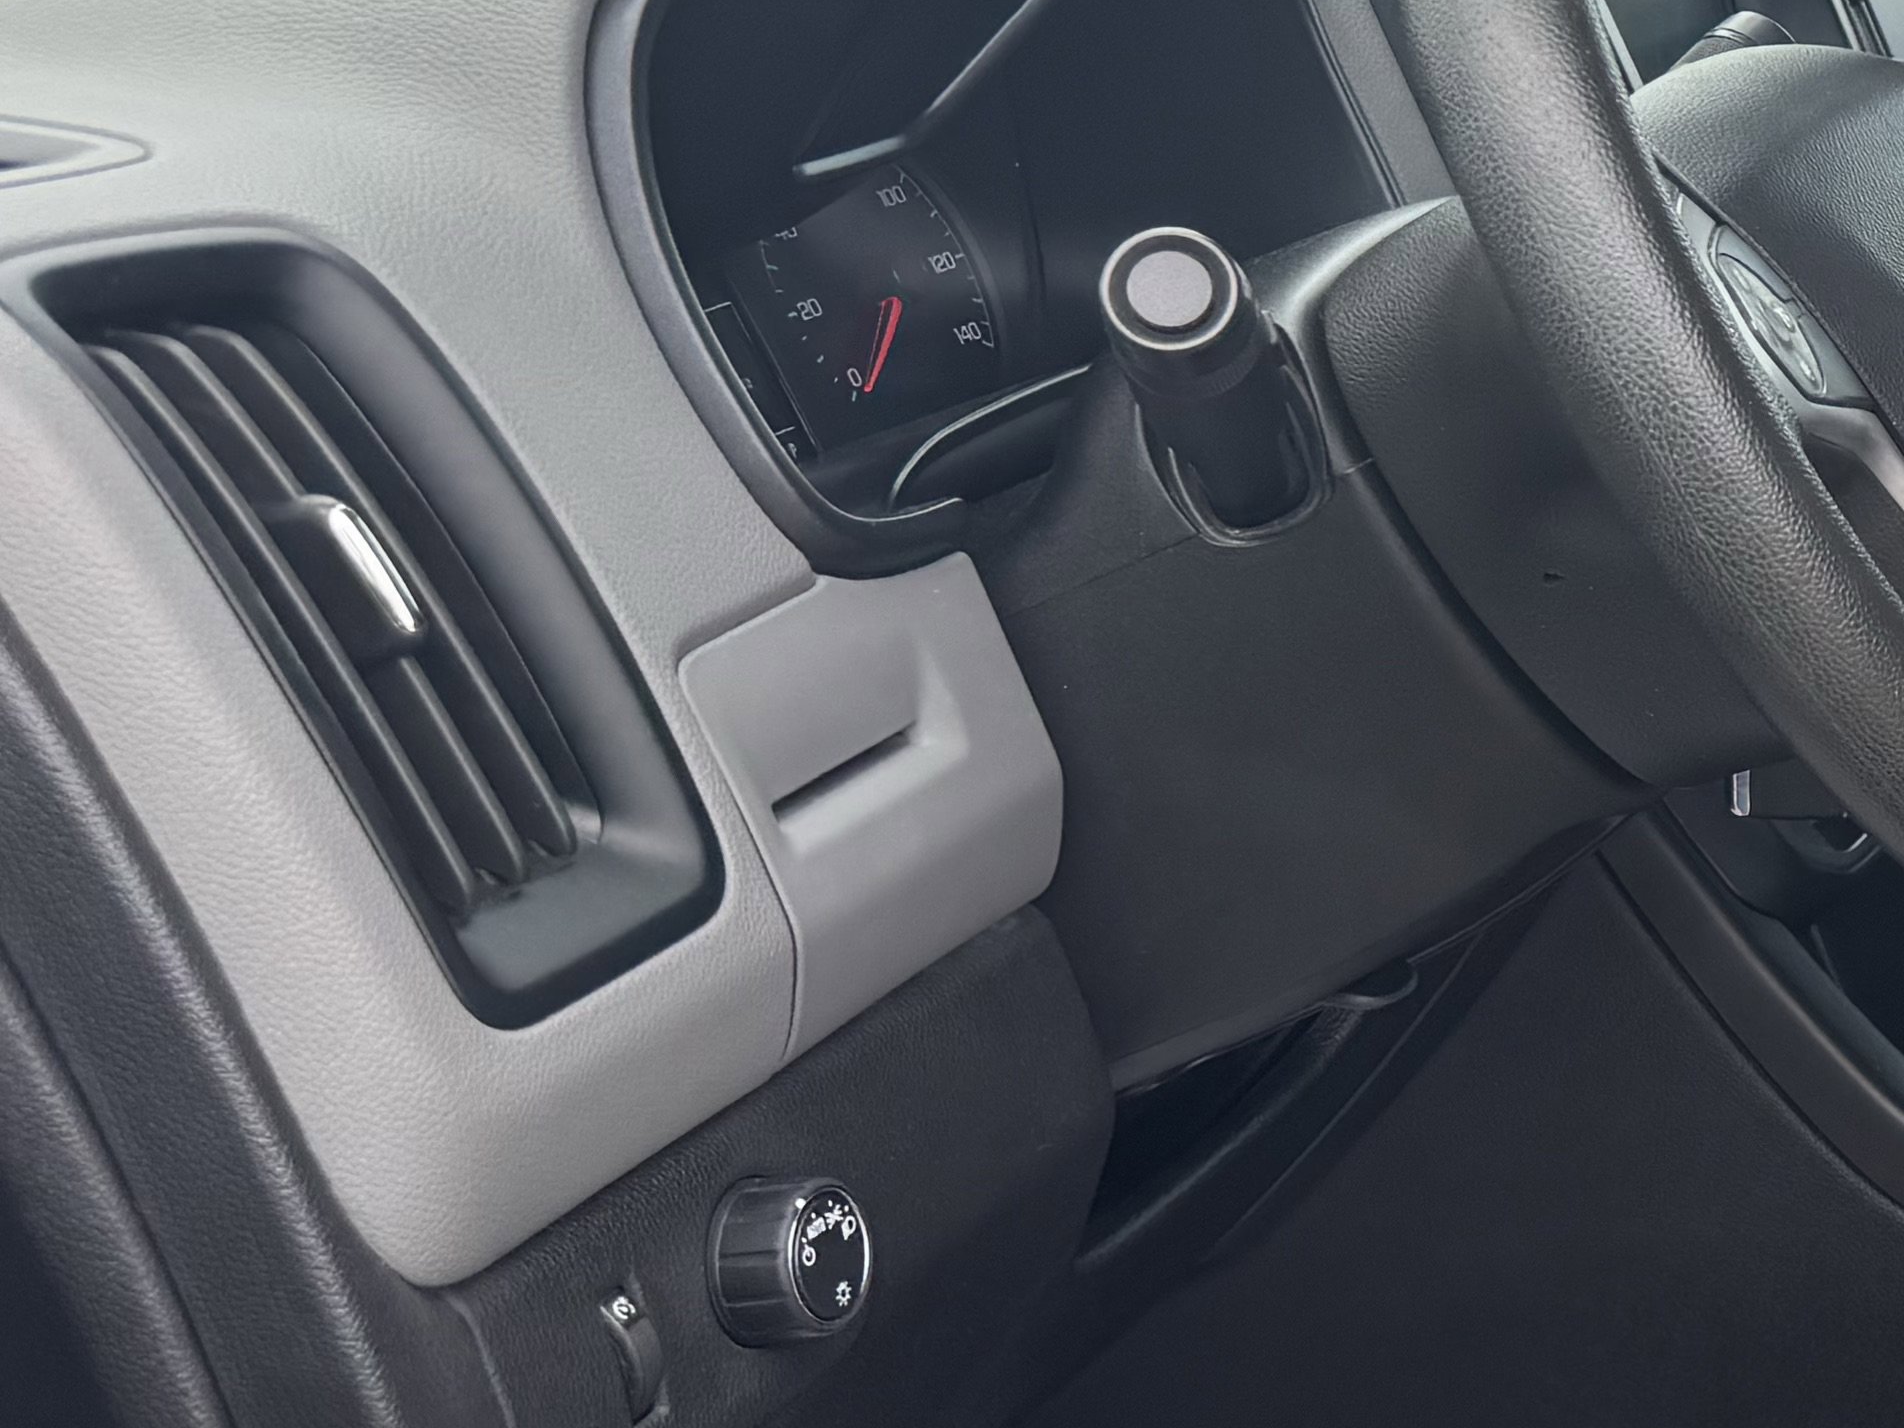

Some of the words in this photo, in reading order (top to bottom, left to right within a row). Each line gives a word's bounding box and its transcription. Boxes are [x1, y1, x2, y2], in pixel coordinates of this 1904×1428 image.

[876, 185, 907, 207] 100
[928, 251, 956, 274] 120
[797, 298, 823, 321] 20
[953, 322, 982, 345] 140
[846, 368, 862, 387] 0
